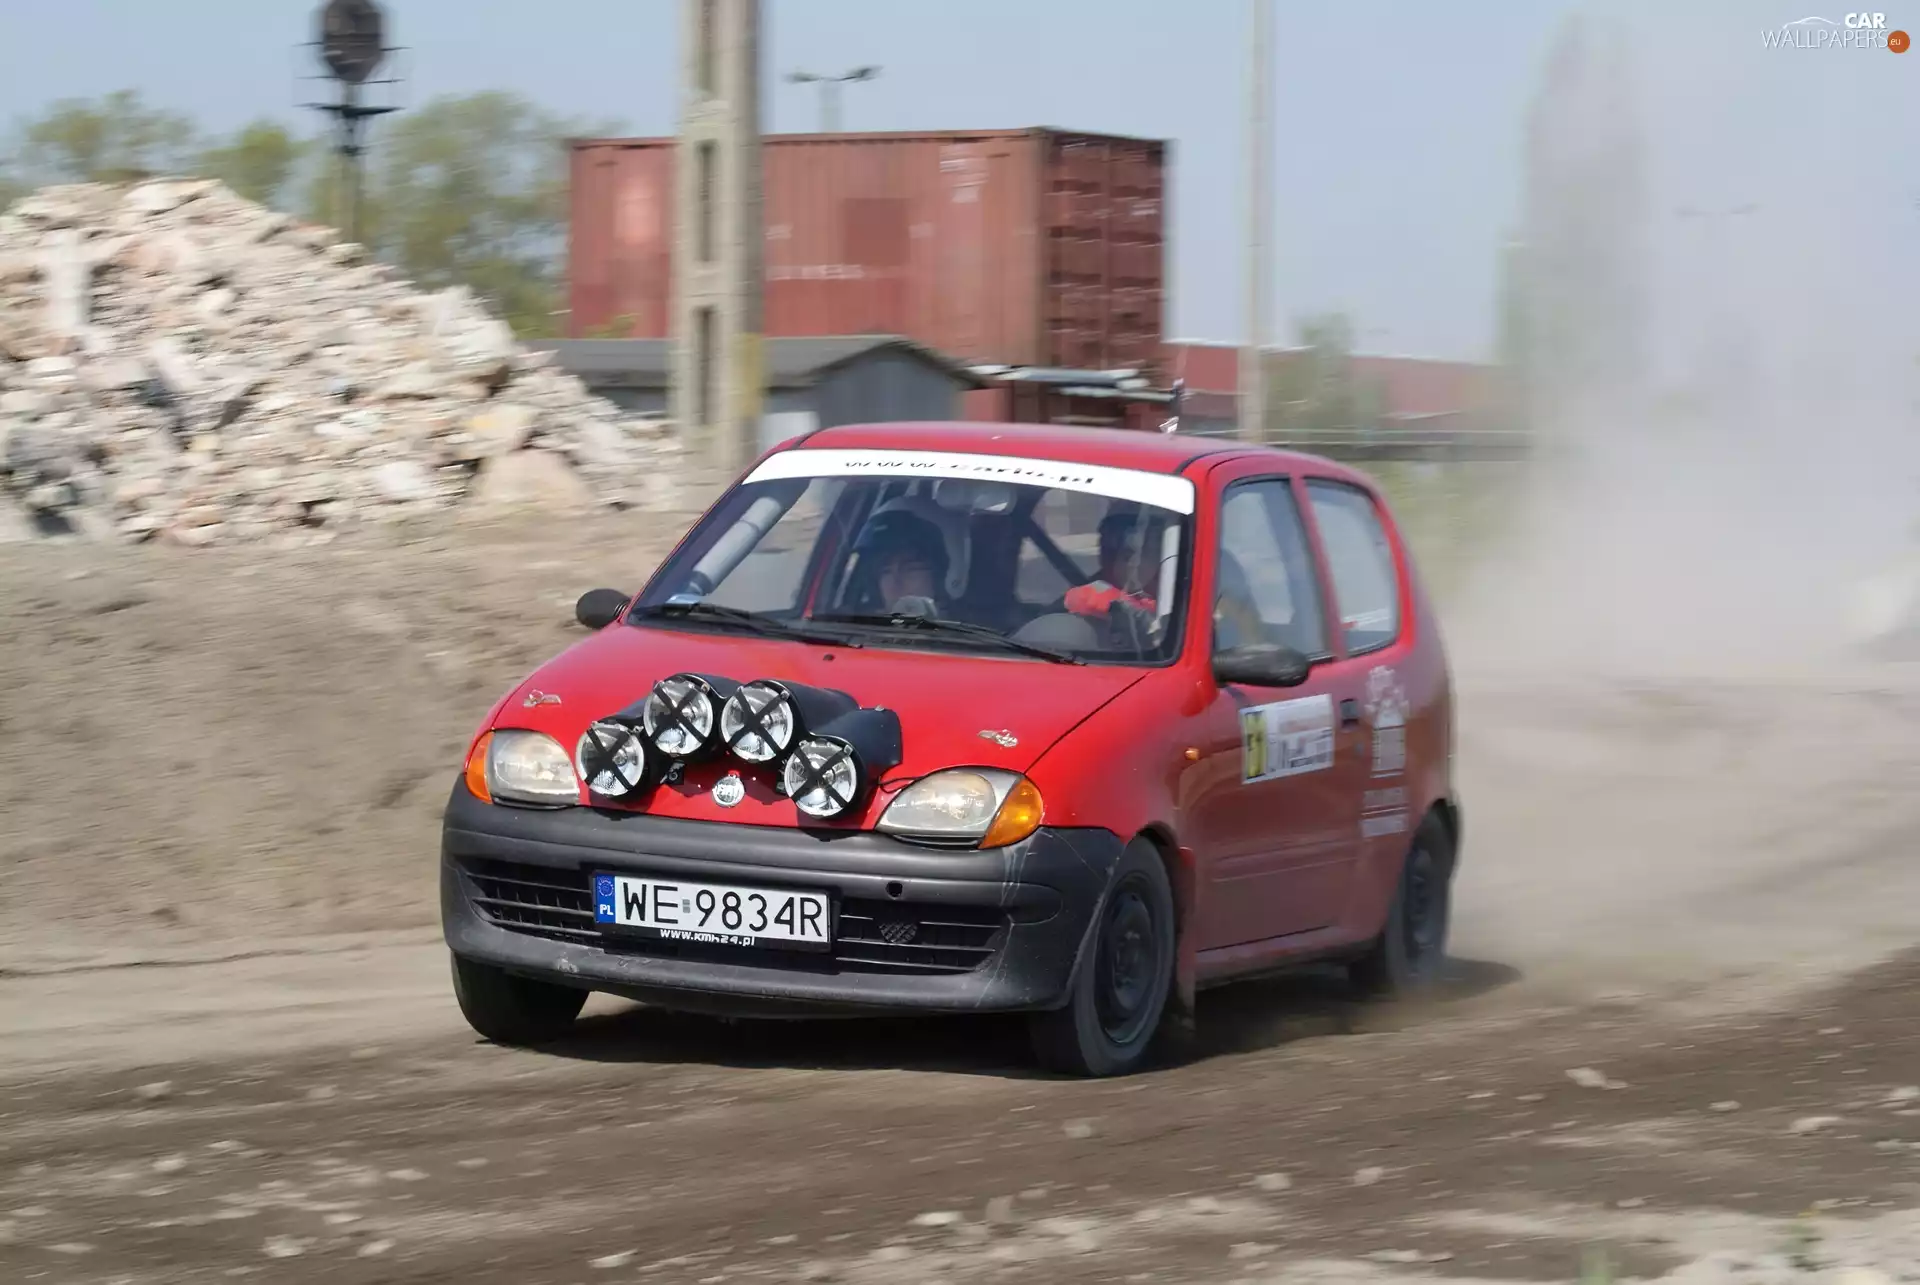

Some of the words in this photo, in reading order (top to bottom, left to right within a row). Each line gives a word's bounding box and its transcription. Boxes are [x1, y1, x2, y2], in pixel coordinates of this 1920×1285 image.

[599, 903, 614, 916] PL
[623, 881, 679, 925] WE
[695, 888, 823, 937] 9834R
